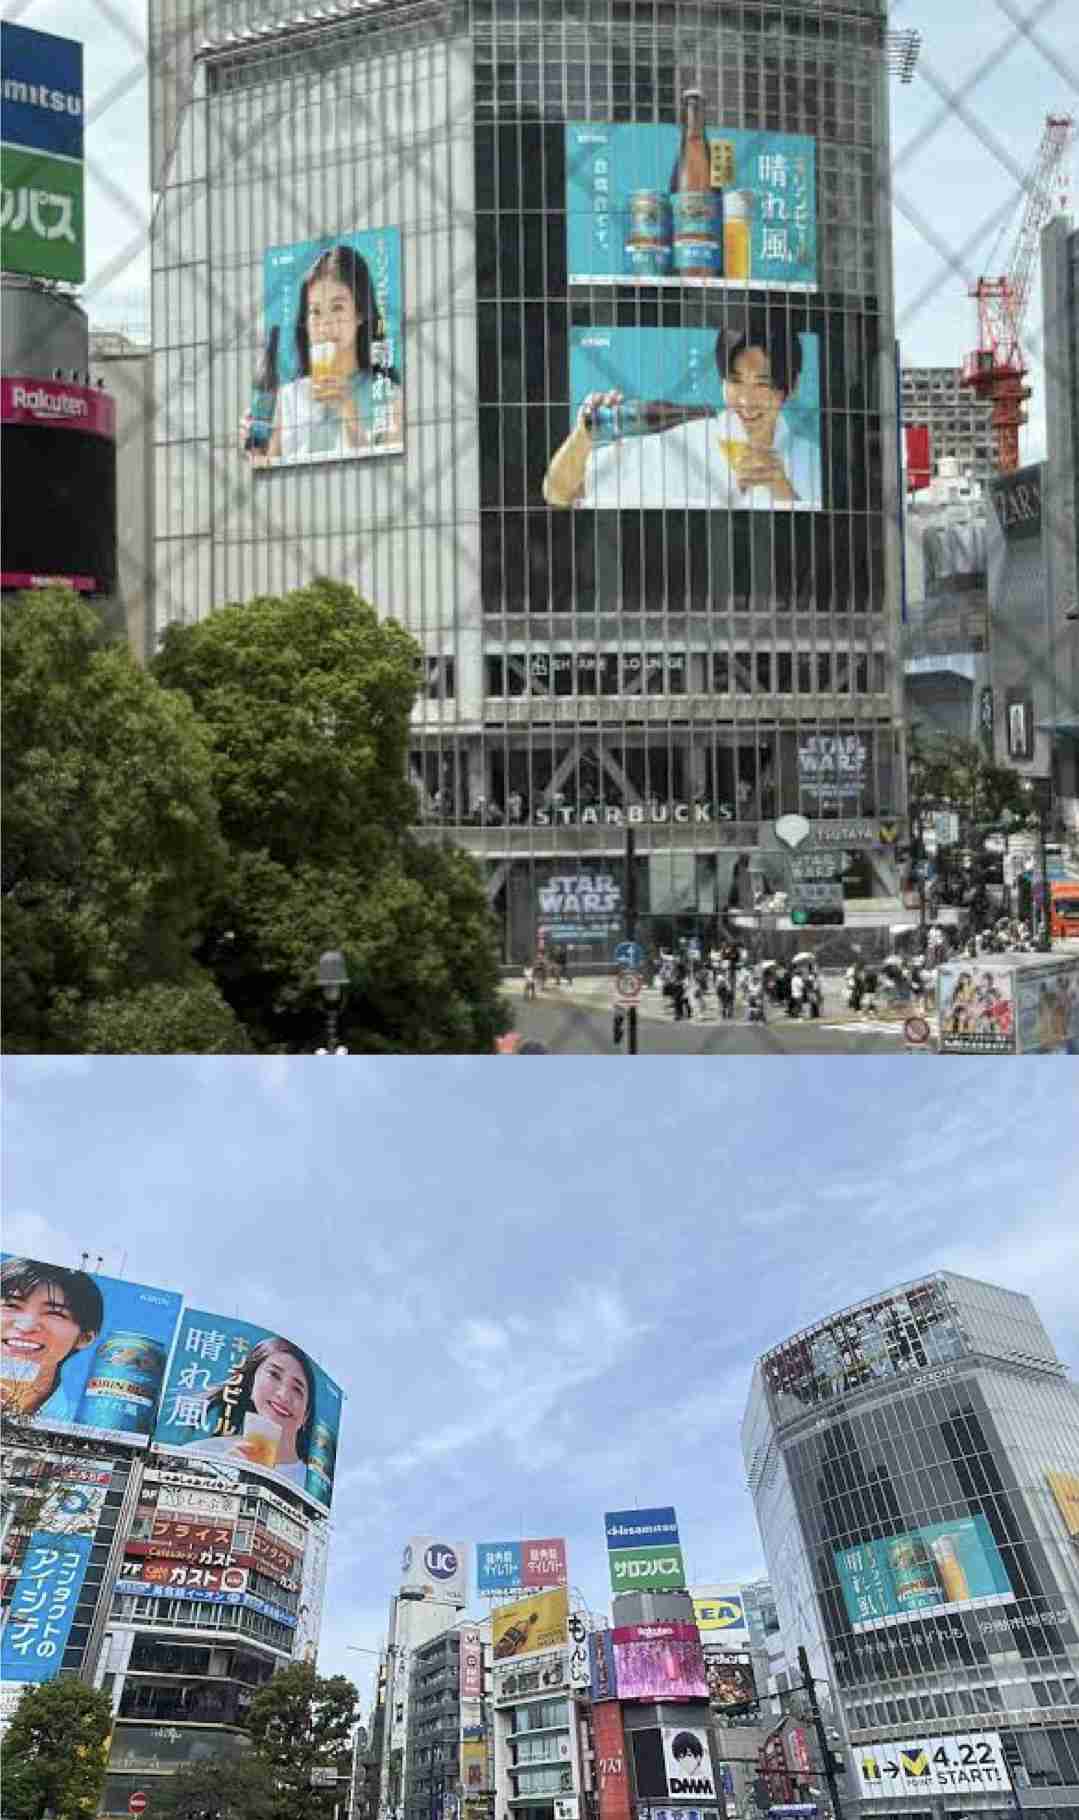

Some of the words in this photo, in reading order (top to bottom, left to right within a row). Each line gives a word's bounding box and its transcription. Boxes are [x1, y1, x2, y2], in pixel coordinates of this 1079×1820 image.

[0, 76, 83, 116] mitsu
[757, 153, 787, 262] 晴れ風
[12, 385, 89, 418] Rakuten
[1001, 478, 1040, 530] ZAR
[800, 754, 865, 772] WARS
[535, 803, 734, 827] STARBUCKS
[538, 876, 620, 894] STAR
[539, 892, 620, 913] WARS
[165, 1327, 226, 1433] 晴れ風
[215, 1335, 250, 1435] キリンビール
[121, 1561, 143, 1575] 7F
[199, 1550, 238, 1568] ガスト
[426, 1552, 457, 1572] UC
[168, 1567, 219, 1587] ガスト
[10, 1548, 60, 1656] アイシティ
[36, 1552, 82, 1658] コンタクトの
[702, 1606, 736, 1620] EA
[932, 1742, 996, 1767] 4.22
[669, 1777, 714, 1794] DMM
[936, 1768, 1002, 1786] START!
